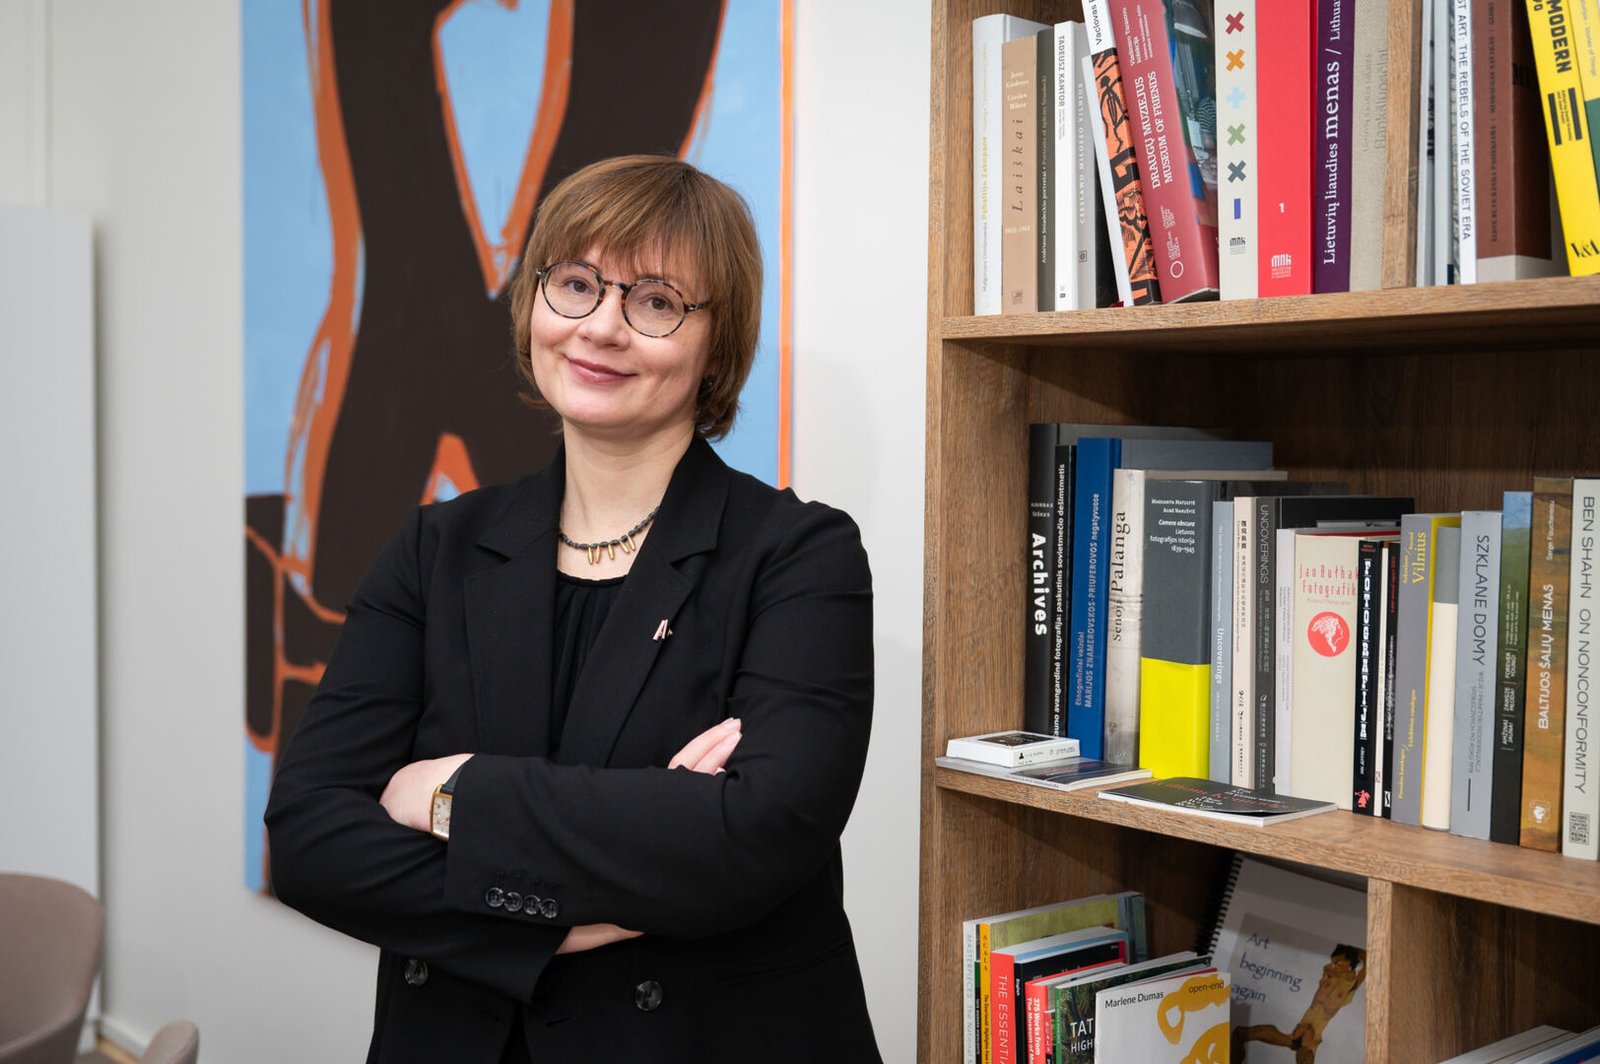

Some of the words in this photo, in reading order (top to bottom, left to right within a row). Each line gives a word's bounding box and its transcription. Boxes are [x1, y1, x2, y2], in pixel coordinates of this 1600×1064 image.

[1091, 4, 1103, 45] Vaclovas
[1329, 0, 1341, 41] Lithua
[1458, 15, 1468, 41] ART:
[1546, 0, 1573, 73] MODERN
[1459, 45, 1468, 67] THE
[1134, 76, 1152, 135] MUZIEJUS
[1148, 71, 1162, 117] FRIENDS
[1325, 61, 1340, 139] menas
[1459, 71, 1470, 118] REBELS
[1155, 120, 1165, 132] OF
[1460, 121, 1470, 137] OF
[1011, 118, 1024, 212] Laiškai
[1145, 138, 1161, 189] DRAUGŲ
[1158, 135, 1173, 184] MUSEUM
[1324, 143, 1338, 200] liaudies
[1460, 142, 1470, 165] THE
[1278, 202, 1285, 213] 1
[1460, 169, 1471, 211] SOVIET
[1323, 202, 1340, 264] Lietuvių
[1461, 216, 1472, 241] ERA
[1056, 464, 1065, 516] dešimtmetis
[1158, 518, 1176, 526] Camera
[1582, 496, 1595, 532] BEN
[1055, 517, 1065, 568] sovietmečio
[1111, 511, 1131, 593] Palanga
[1149, 535, 1177, 545] fotografijos
[1177, 537, 1195, 545] istorija
[1259, 504, 1270, 584] UNCOVERINGS
[1411, 532, 1426, 583] Vilnius
[1031, 532, 1051, 636] Archives
[1474, 535, 1490, 608] SZKLANE
[1580, 536, 1594, 599] SHAHN
[1055, 570, 1064, 613] paskutinis
[1084, 670, 1093, 708] MARIJOS
[1091, 493, 1100, 540] negatyvuose
[1542, 584, 1554, 631] MENAS
[1053, 614, 1063, 660] fotografija:
[1112, 599, 1126, 641] Senoji
[1472, 613, 1487, 666] DOMY
[1578, 608, 1592, 635] ON
[1214, 627, 1225, 685] Uncoverings
[1538, 634, 1554, 669] ŠALIŲ
[1053, 662, 1062, 713] avangardinė
[1538, 671, 1551, 729] BALTIJOS
[1053, 714, 1061, 738] auno
[1574, 640, 1591, 794] NONCONFORMITY
[1247, 932, 1271, 949] Art
[966, 933, 974, 998] MASTERPIECES
[998, 975, 1008, 999] THE
[1239, 951, 1303, 993] beginning
[966, 1005, 974, 1016] The
[1033, 998, 1041, 1012] 375
[1104, 995, 1135, 1009] Marlene
[1137, 991, 1164, 1003] Dumas
[1188, 981, 1224, 994] open-end
[1231, 984, 1266, 1003] again
[966, 1023, 974, 1057] National
[1028, 1044, 1035, 1053] of
[1034, 1036, 1042, 1056] from
